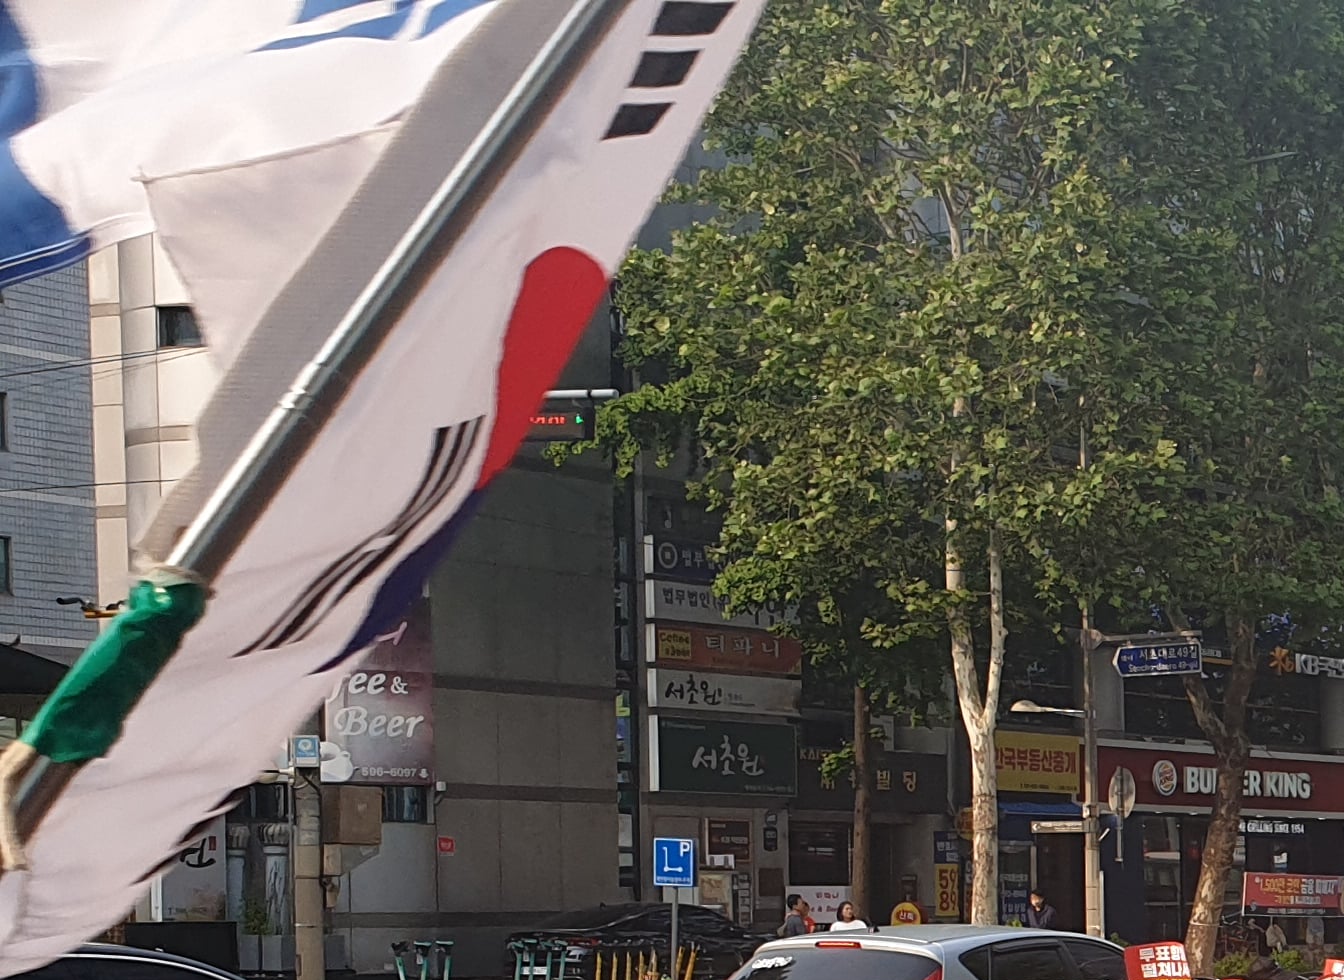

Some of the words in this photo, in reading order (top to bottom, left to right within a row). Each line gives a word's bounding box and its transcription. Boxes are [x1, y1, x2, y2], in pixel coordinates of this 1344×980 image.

[665, 674, 722, 705] 서초원
[333, 705, 424, 738] Beer
[692, 735, 764, 775] 서초원
[1184, 766, 1262, 797] BUER
[1263, 771, 1311, 799] KING
[680, 842, 690, 857] P
